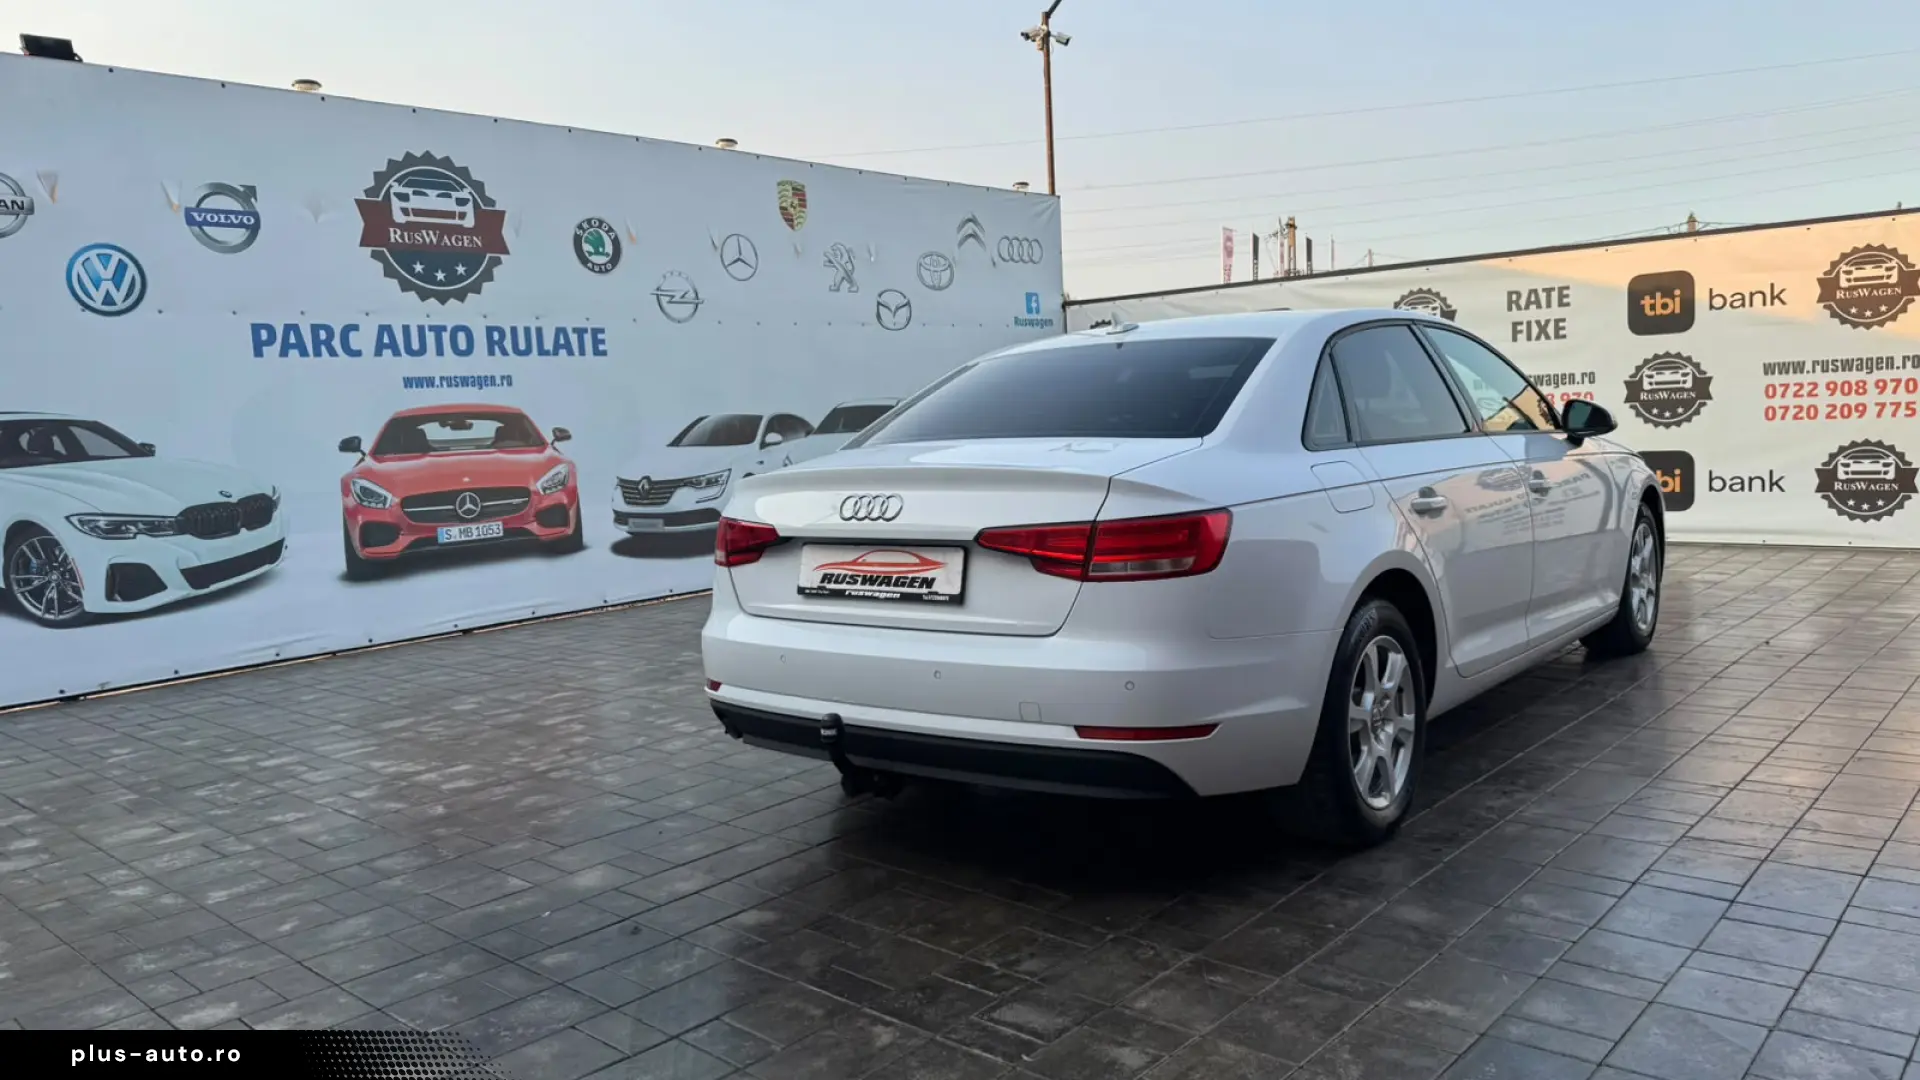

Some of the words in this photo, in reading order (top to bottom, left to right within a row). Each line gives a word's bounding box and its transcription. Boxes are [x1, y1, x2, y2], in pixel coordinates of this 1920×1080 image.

[190, 211, 255, 225] VOLVO
[587, 262, 612, 271] AUTO
[1506, 285, 1571, 312] RATE
[1640, 289, 1681, 316] tbi
[1708, 282, 1787, 311] bank
[1014, 316, 1053, 329] Ruswagen
[1511, 318, 1567, 342] FIXE
[250, 322, 363, 358] PARC
[373, 323, 475, 358] AUTO
[485, 325, 608, 357] RULATE
[1763, 353, 1920, 376] www.ruswagen.ro
[402, 373, 513, 391] www.ruswagen.ro
[1764, 382, 1819, 399] 0722
[1825, 379, 1868, 397] 908
[1874, 377, 1919, 395] 970
[1764, 404, 1819, 421] 0720
[1825, 402, 1867, 420] 209
[1874, 401, 1917, 418] 775
[1655, 468, 1682, 493] bi
[1708, 469, 1786, 493] bank
[819, 572, 937, 589] RUSWAGEN
[845, 589, 900, 599] ruswagen
